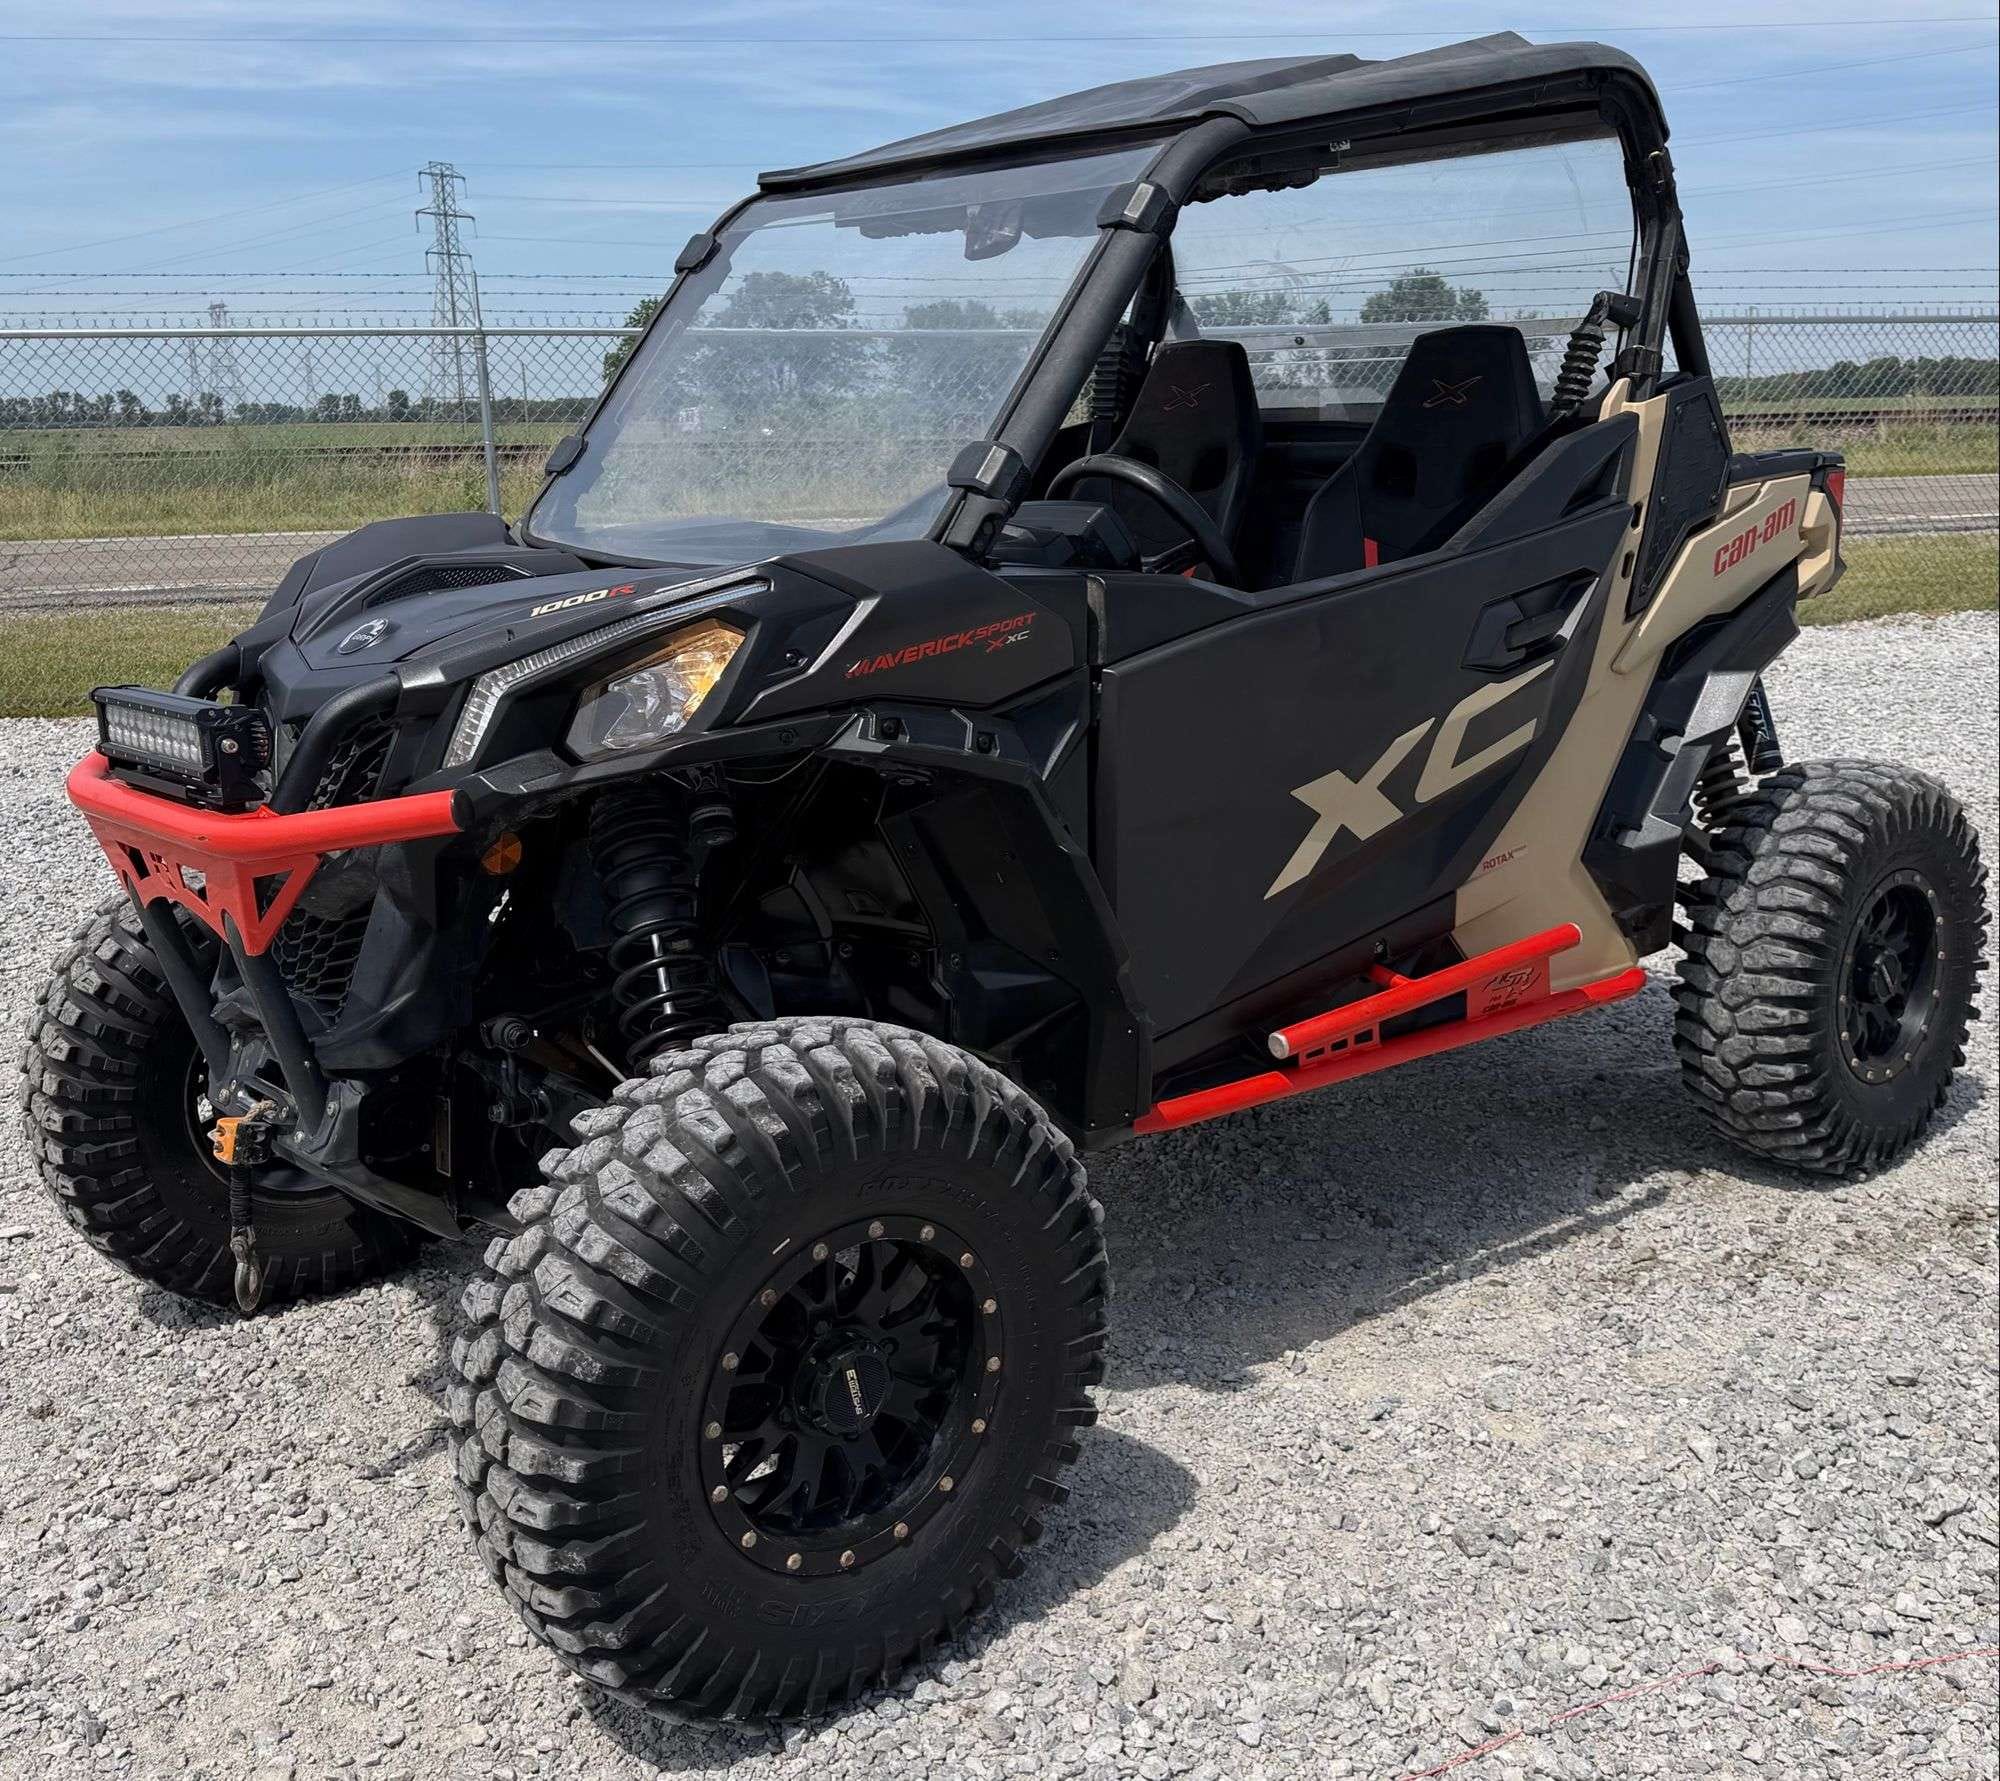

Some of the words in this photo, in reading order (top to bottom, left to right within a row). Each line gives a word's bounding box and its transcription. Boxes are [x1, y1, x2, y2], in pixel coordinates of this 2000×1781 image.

[1713, 497, 1796, 578] can-am
[529, 584, 635, 617] 1000R
[1262, 658, 1555, 900] XC
[1481, 849, 1515, 873] ROTAX
